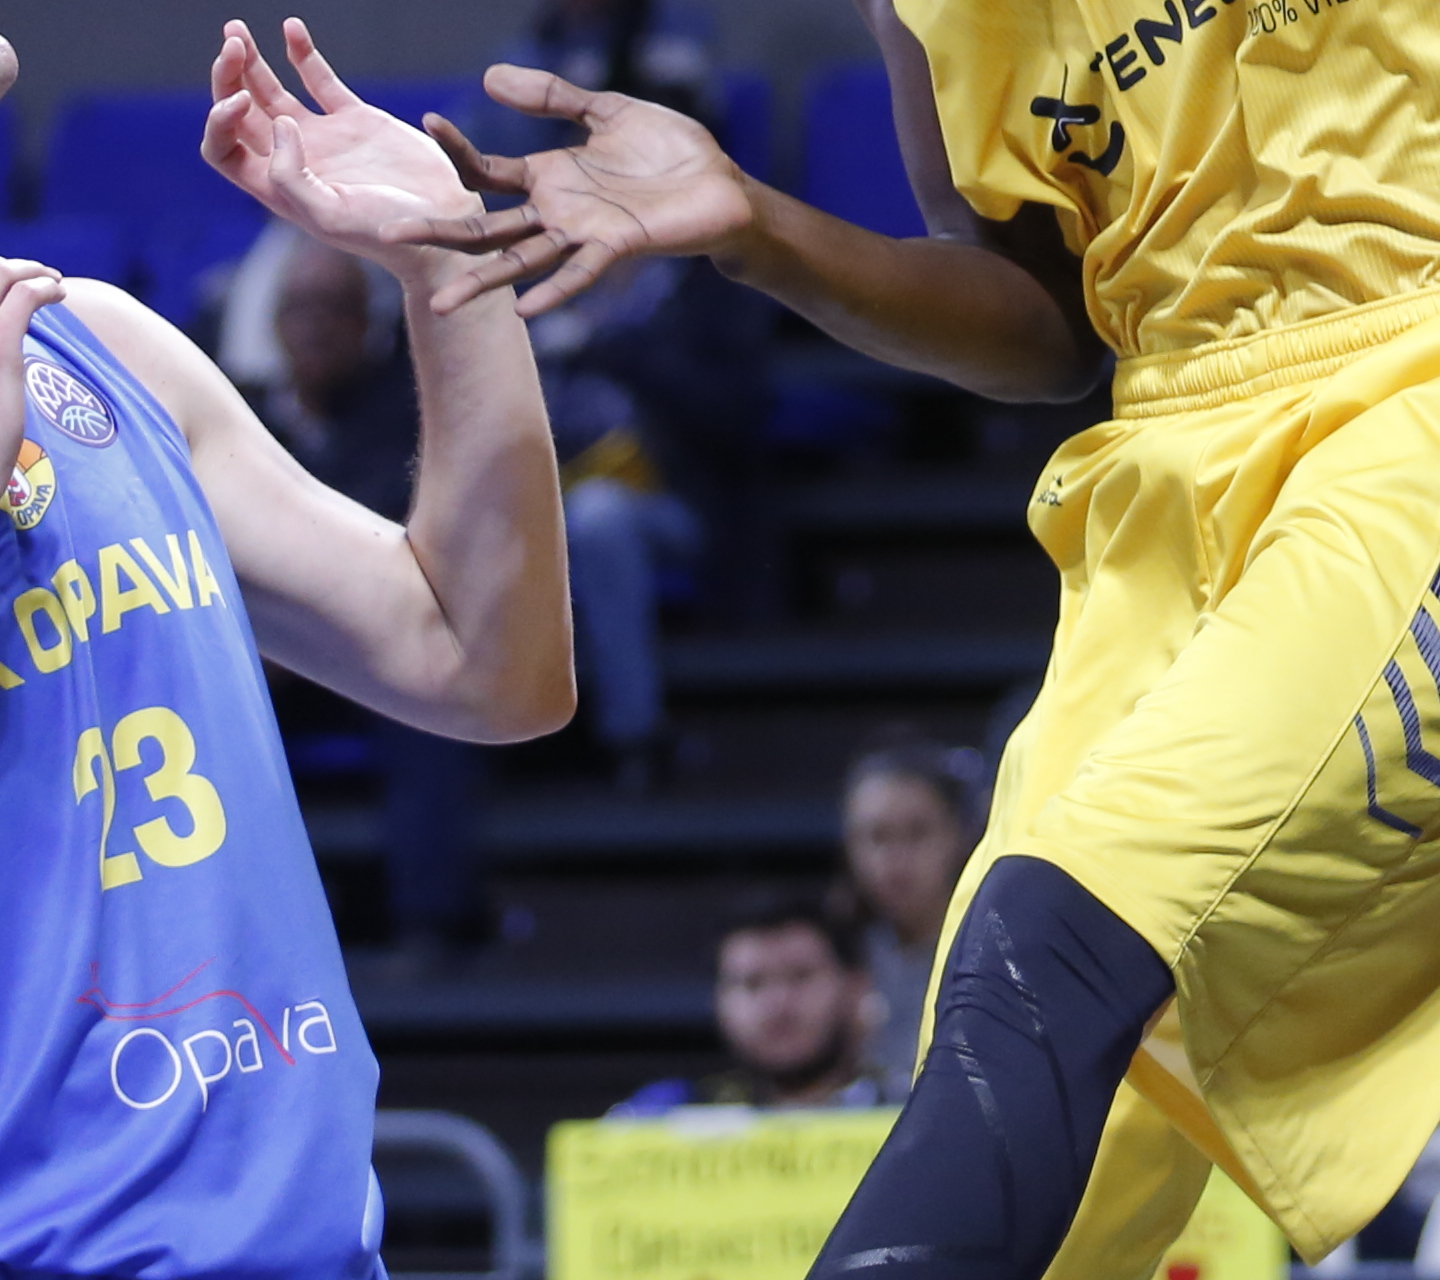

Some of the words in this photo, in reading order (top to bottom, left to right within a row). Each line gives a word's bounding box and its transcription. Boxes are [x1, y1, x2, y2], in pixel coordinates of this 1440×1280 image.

[17, 483, 53, 526] OPAVA
[13, 529, 227, 675] OPAVA
[72, 705, 228, 892] 23
[110, 993, 338, 1113] Opava
